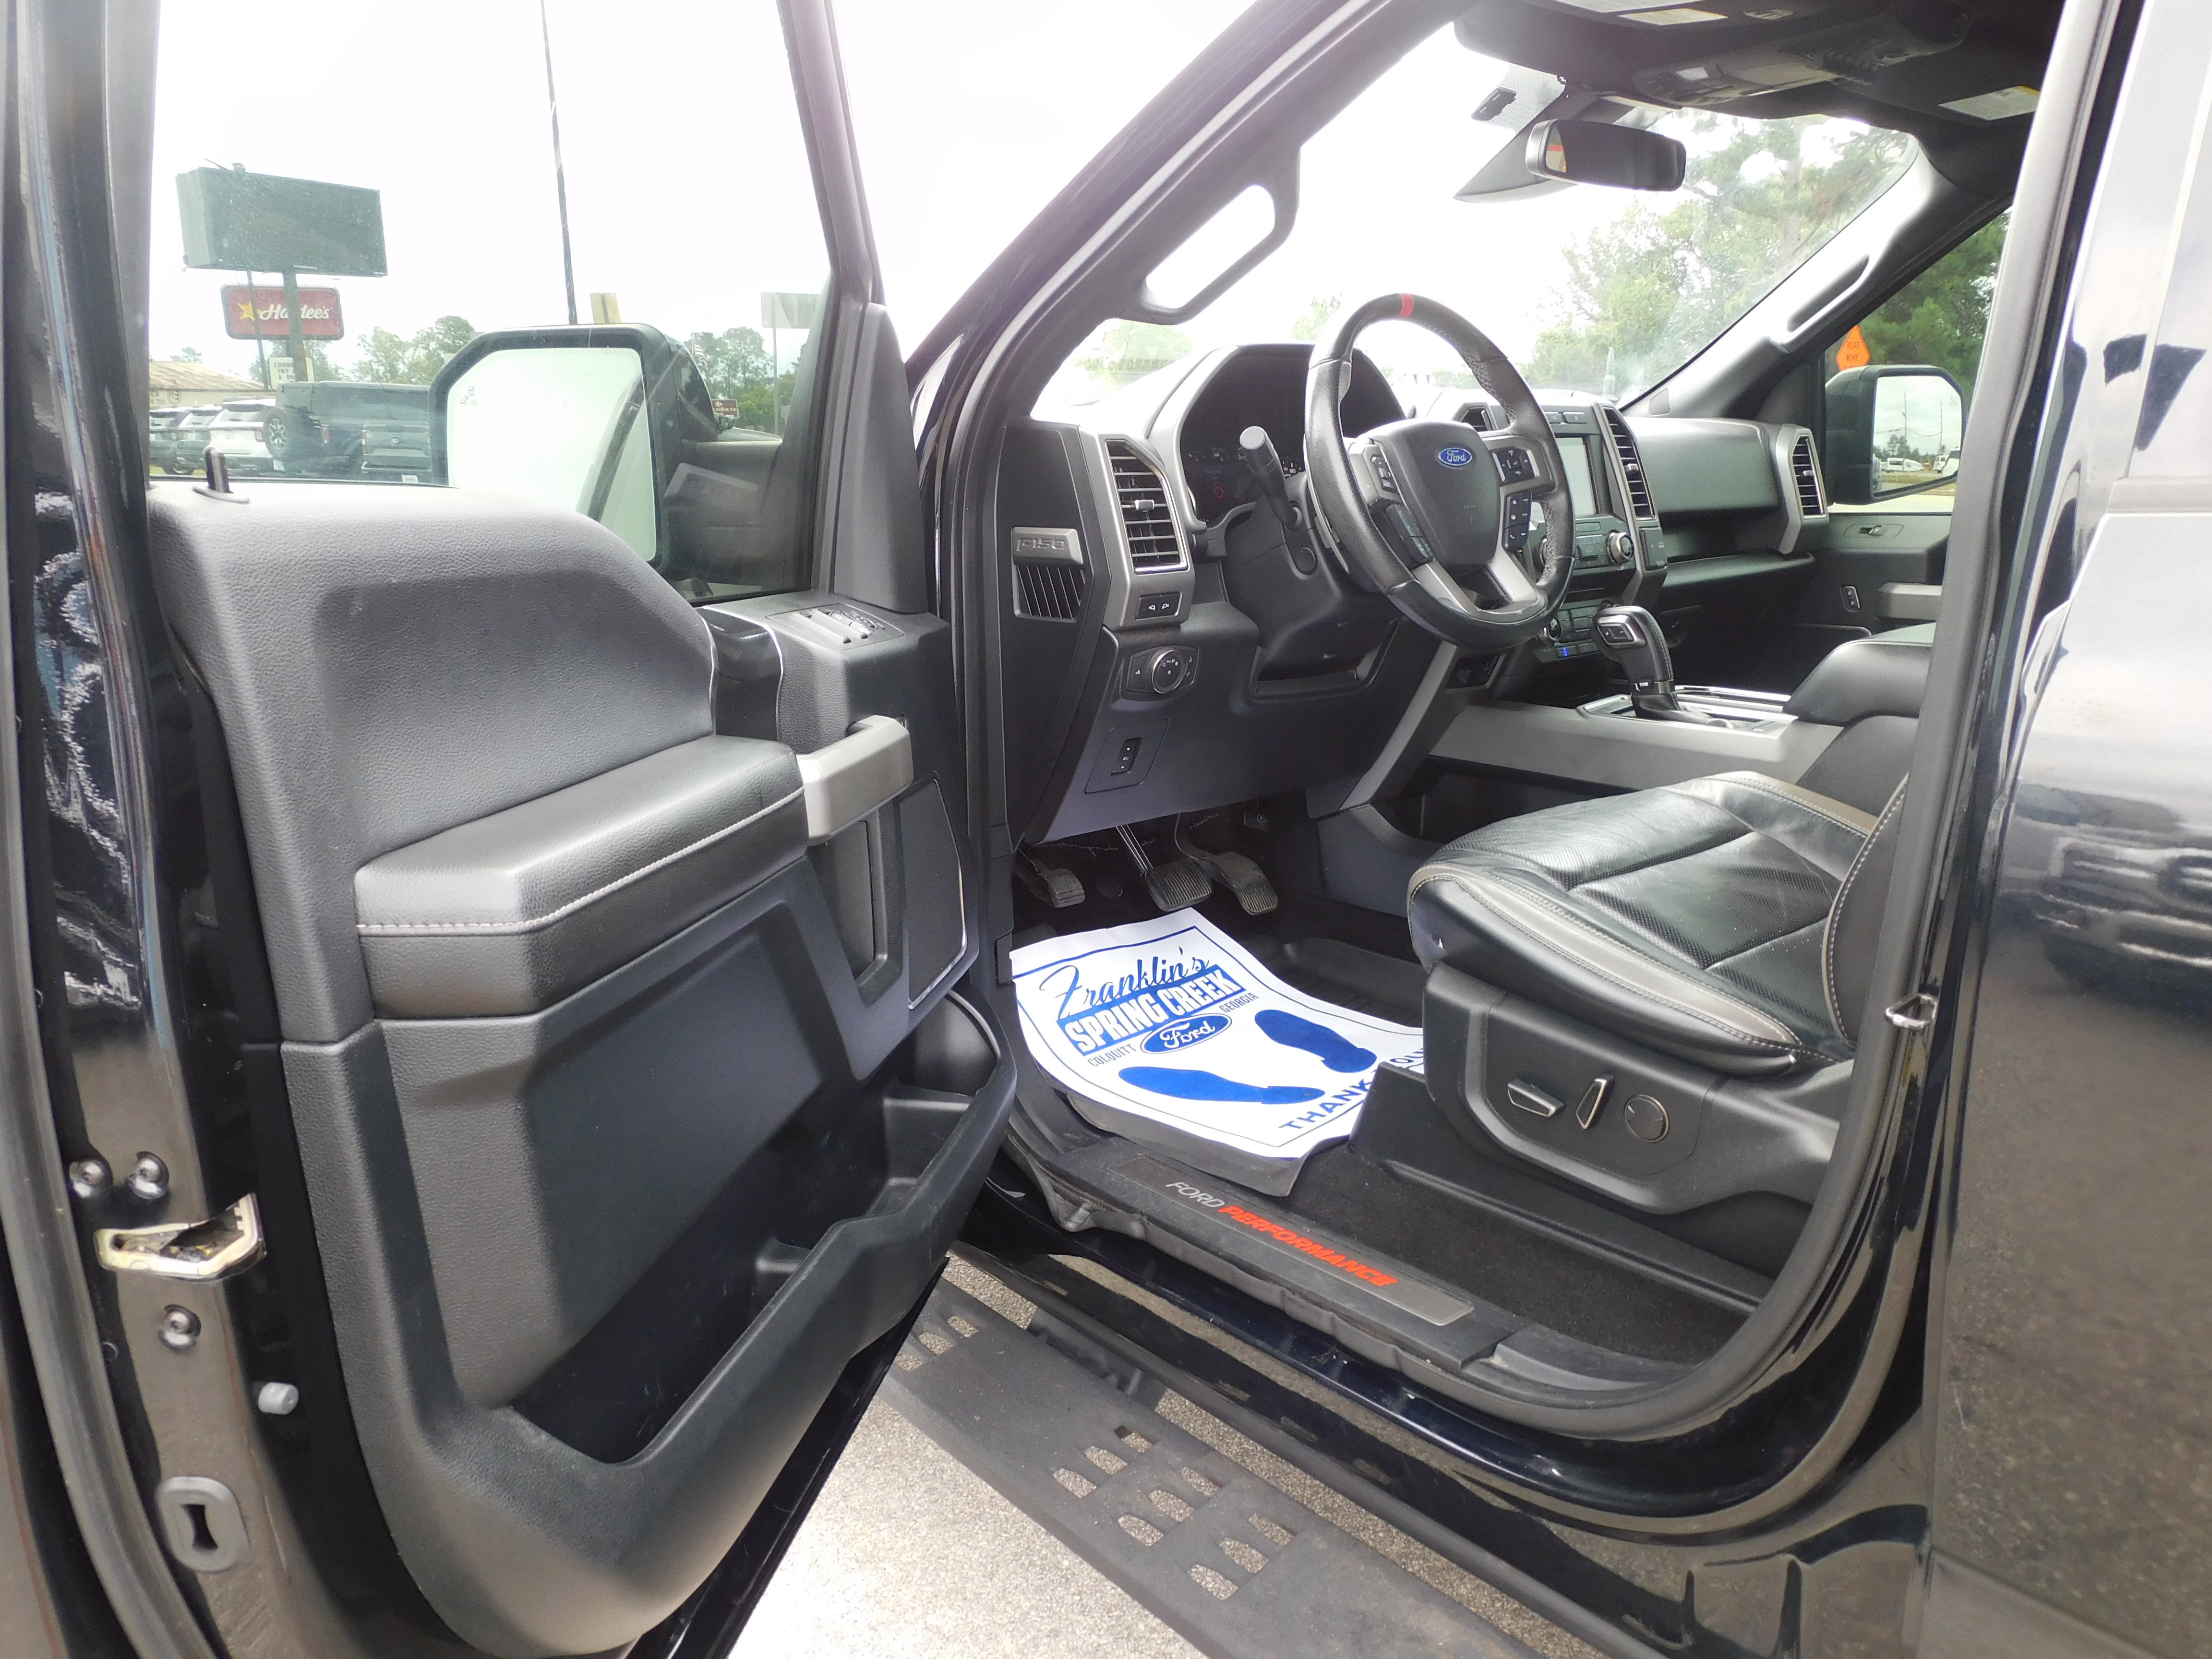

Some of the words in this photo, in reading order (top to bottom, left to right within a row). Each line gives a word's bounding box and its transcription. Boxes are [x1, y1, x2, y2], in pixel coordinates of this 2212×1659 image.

[259, 304, 330, 320] Hadee's
[1447, 450, 1467, 462] Ford
[1039, 946, 1210, 1021] Franklin's
[1064, 992, 1169, 1053] SPRING
[1156, 968, 1242, 1016] CREEK
[1087, 1044, 1137, 1067] COLQUITT
[1159, 1020, 1216, 1049] Ford
[1219, 991, 1260, 1013] GEORGIA
[1278, 1078, 1372, 1129] THANK
[1165, 1181, 1225, 1208] FORD
[1217, 1205, 1398, 1286] PERFORMANCE
